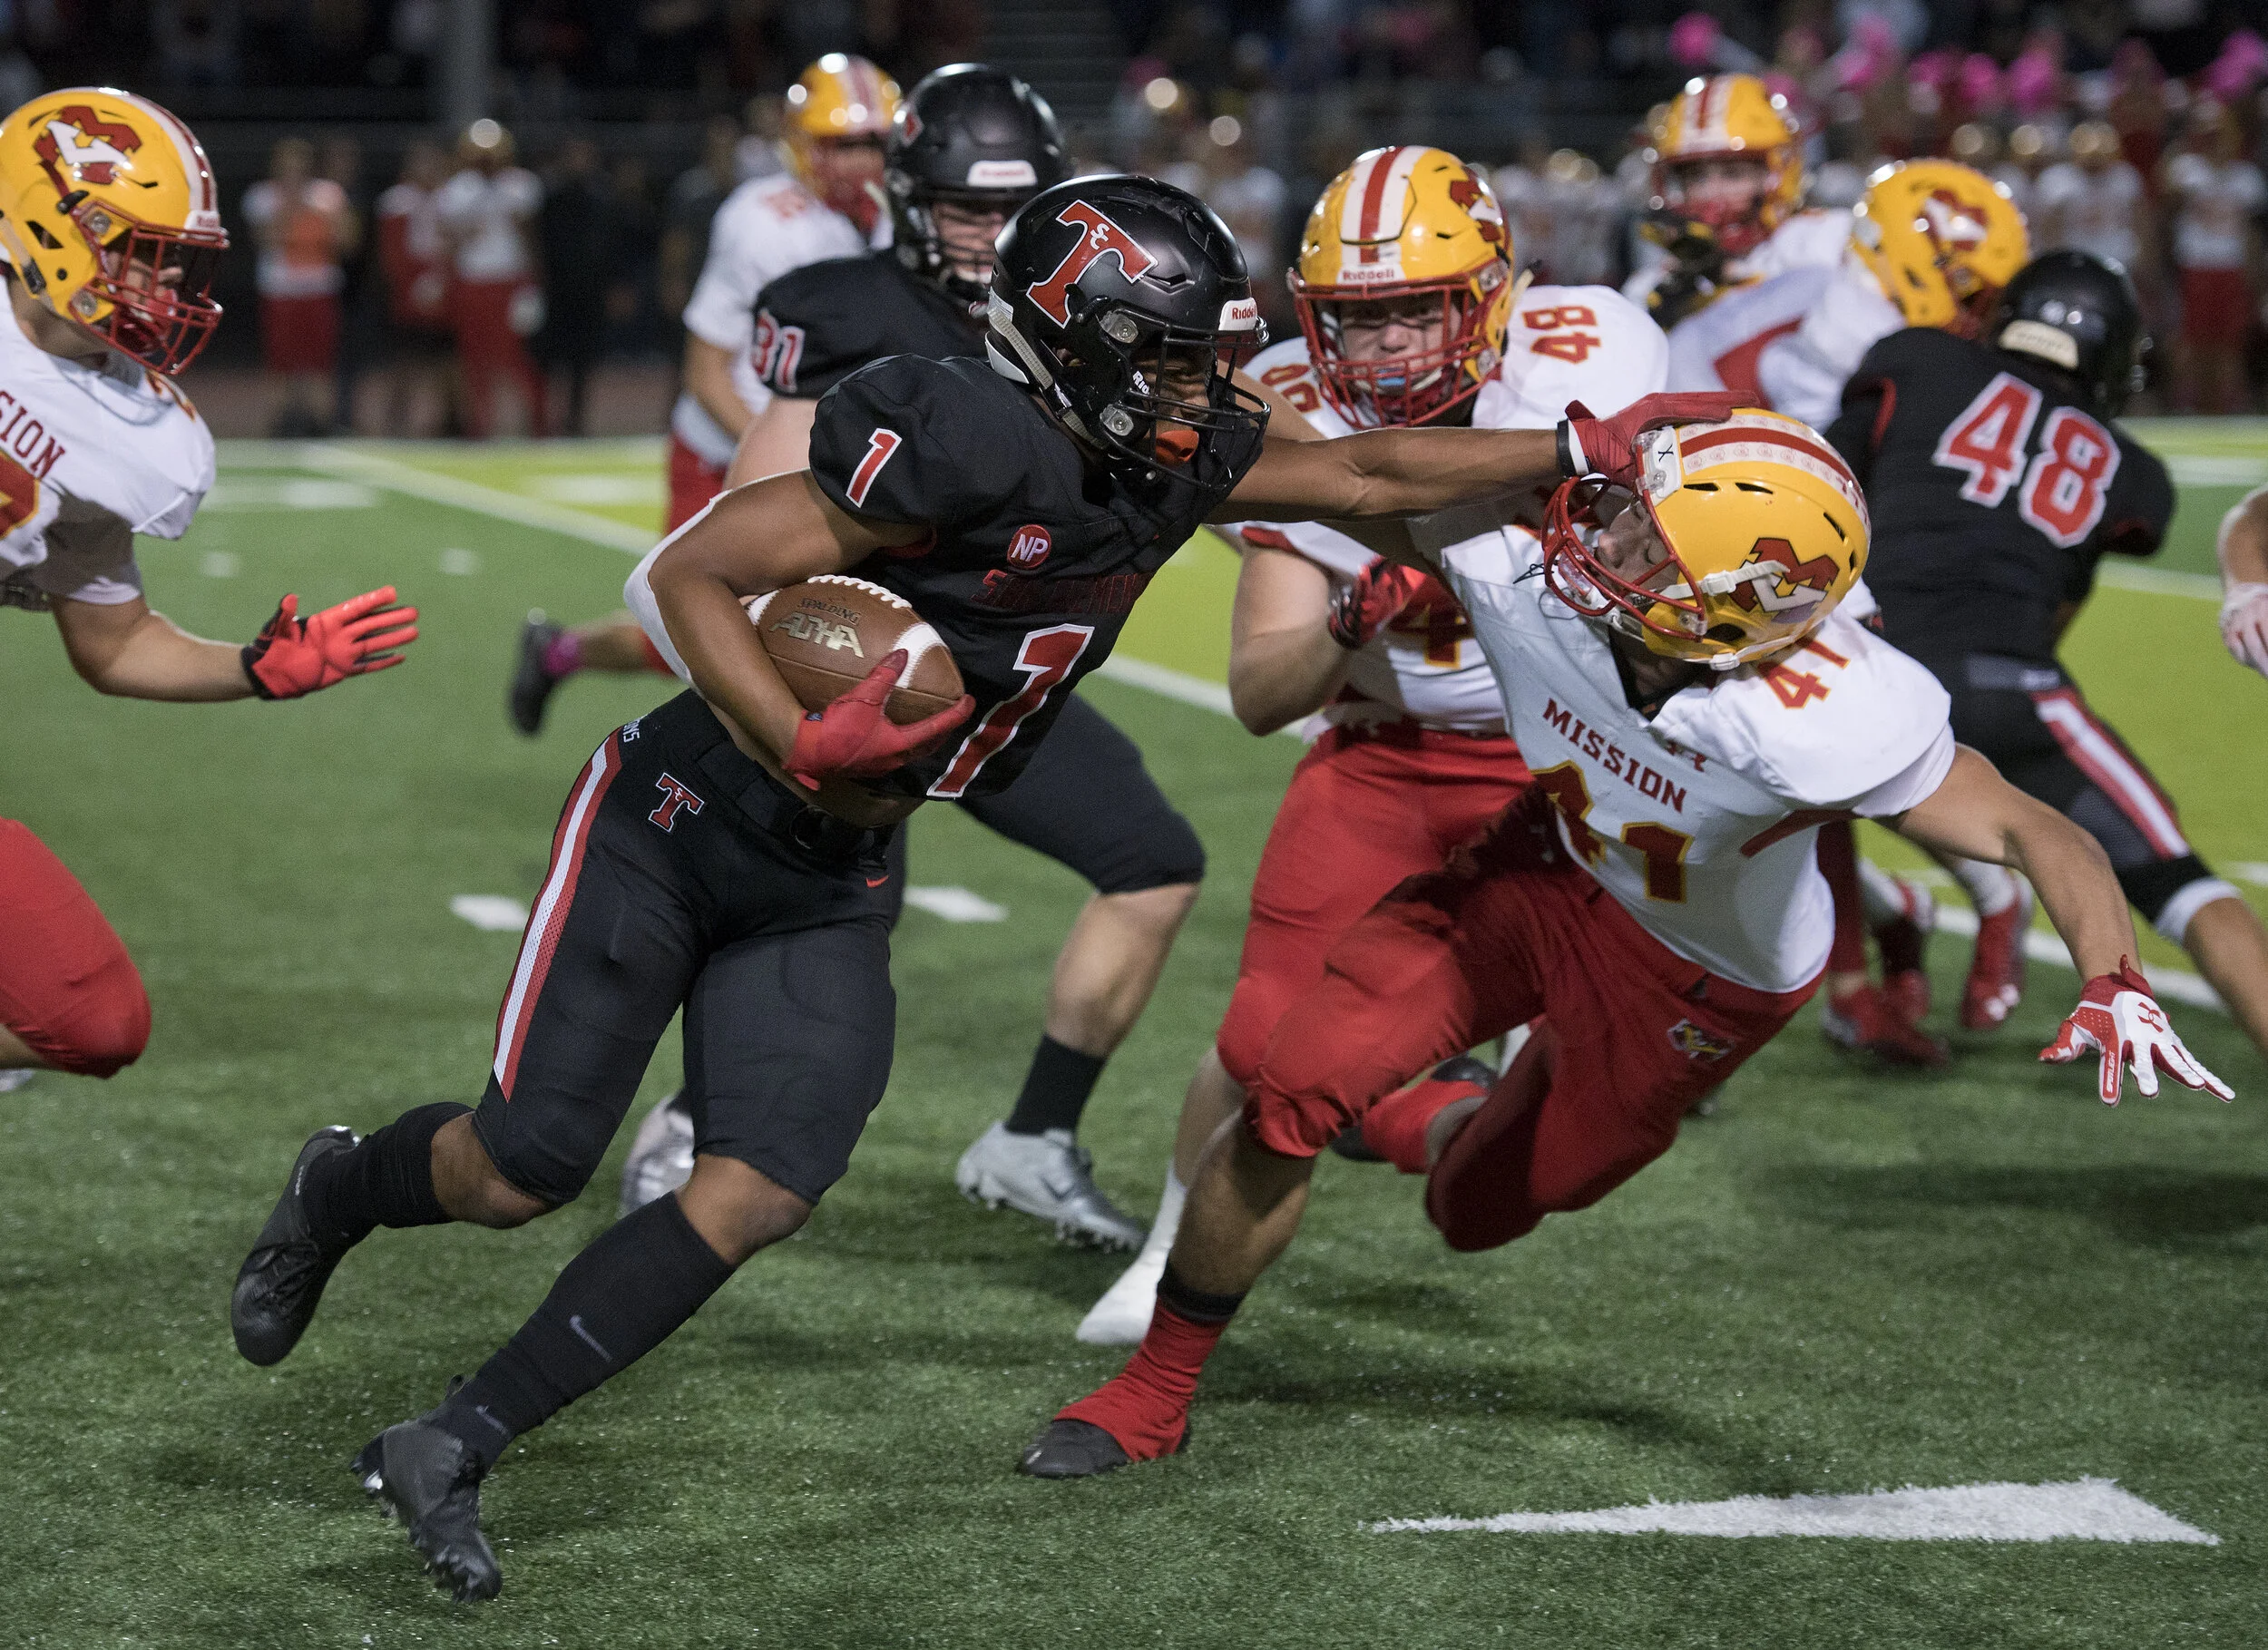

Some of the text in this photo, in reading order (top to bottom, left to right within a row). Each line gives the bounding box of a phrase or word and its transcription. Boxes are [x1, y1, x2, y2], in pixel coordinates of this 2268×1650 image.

[1343, 268, 1394, 280] Riddell
[1521, 305, 1600, 364] 48
[846, 427, 903, 508] 1
[1931, 371, 2121, 549] 48
[1010, 533, 1049, 562] NP
[798, 597, 863, 626] SPALDING
[926, 623, 1095, 798] 1
[1542, 697, 1687, 814] MISSION
